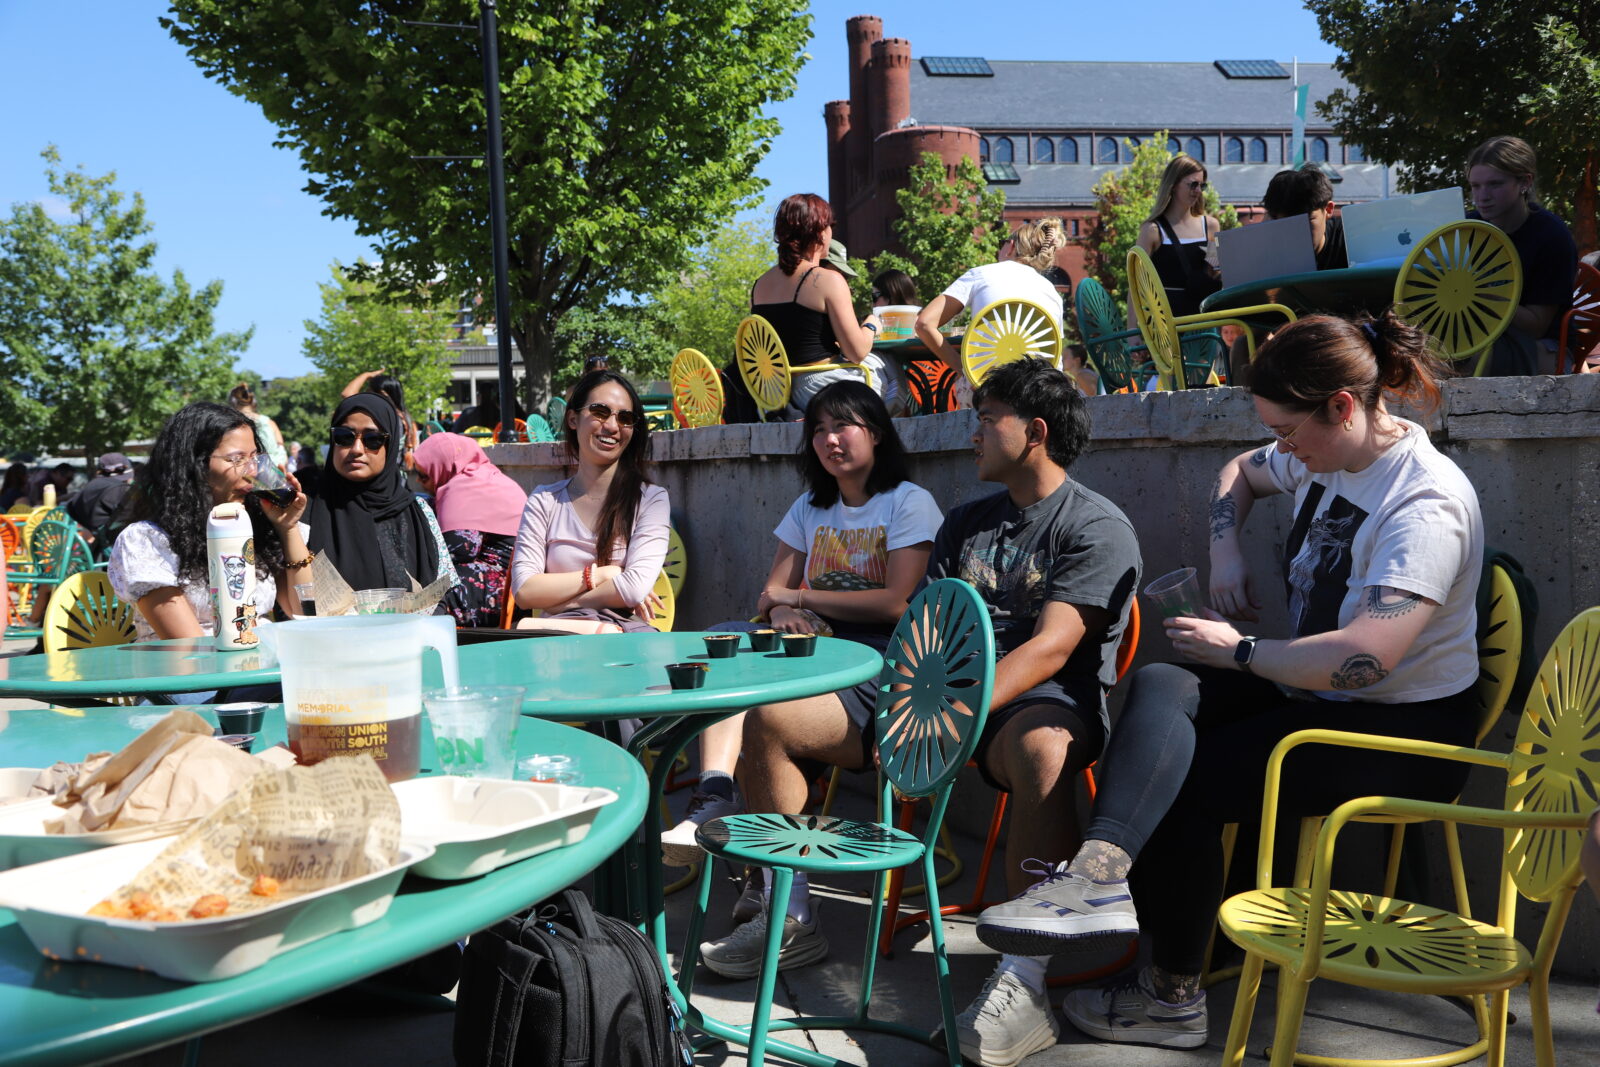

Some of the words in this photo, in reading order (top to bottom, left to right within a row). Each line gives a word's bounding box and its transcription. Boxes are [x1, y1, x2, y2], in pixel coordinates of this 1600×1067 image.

[298, 703, 353, 713] MEMORIAL
[348, 723, 388, 737] UNION
[347, 735, 388, 748] SOUTH
